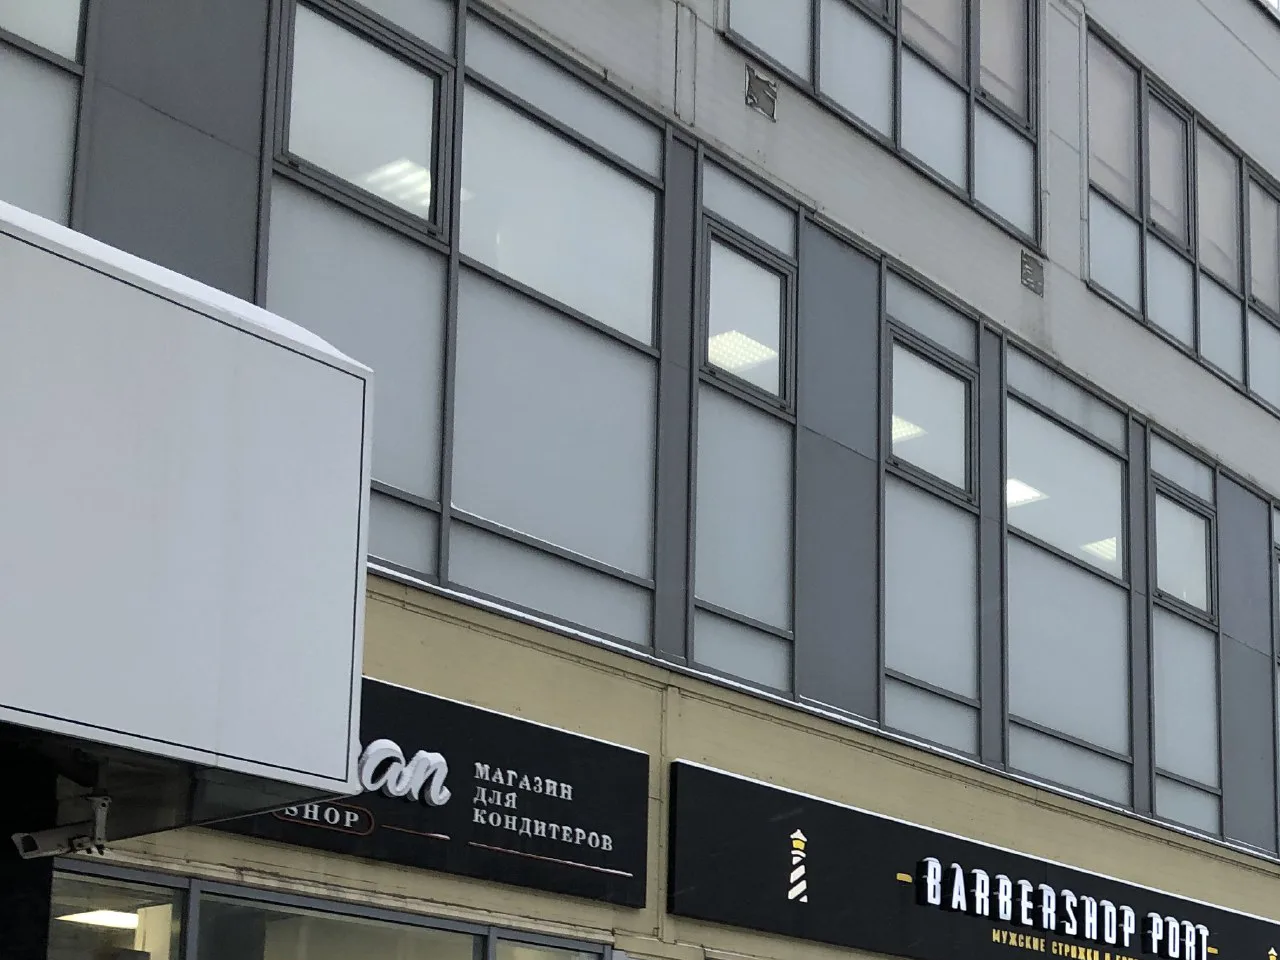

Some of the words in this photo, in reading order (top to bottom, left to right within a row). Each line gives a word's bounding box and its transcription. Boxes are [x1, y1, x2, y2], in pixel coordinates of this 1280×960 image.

[358, 738, 452, 806] an
[474, 762, 573, 801] МАГАЗИН
[473, 786, 518, 809] ДЛЯ
[472, 807, 614, 852] КОНДИТЕРОВ
[922, 857, 1136, 948] BARBERSHOP
[992, 928, 1046, 953] МУЖСКИЕ
